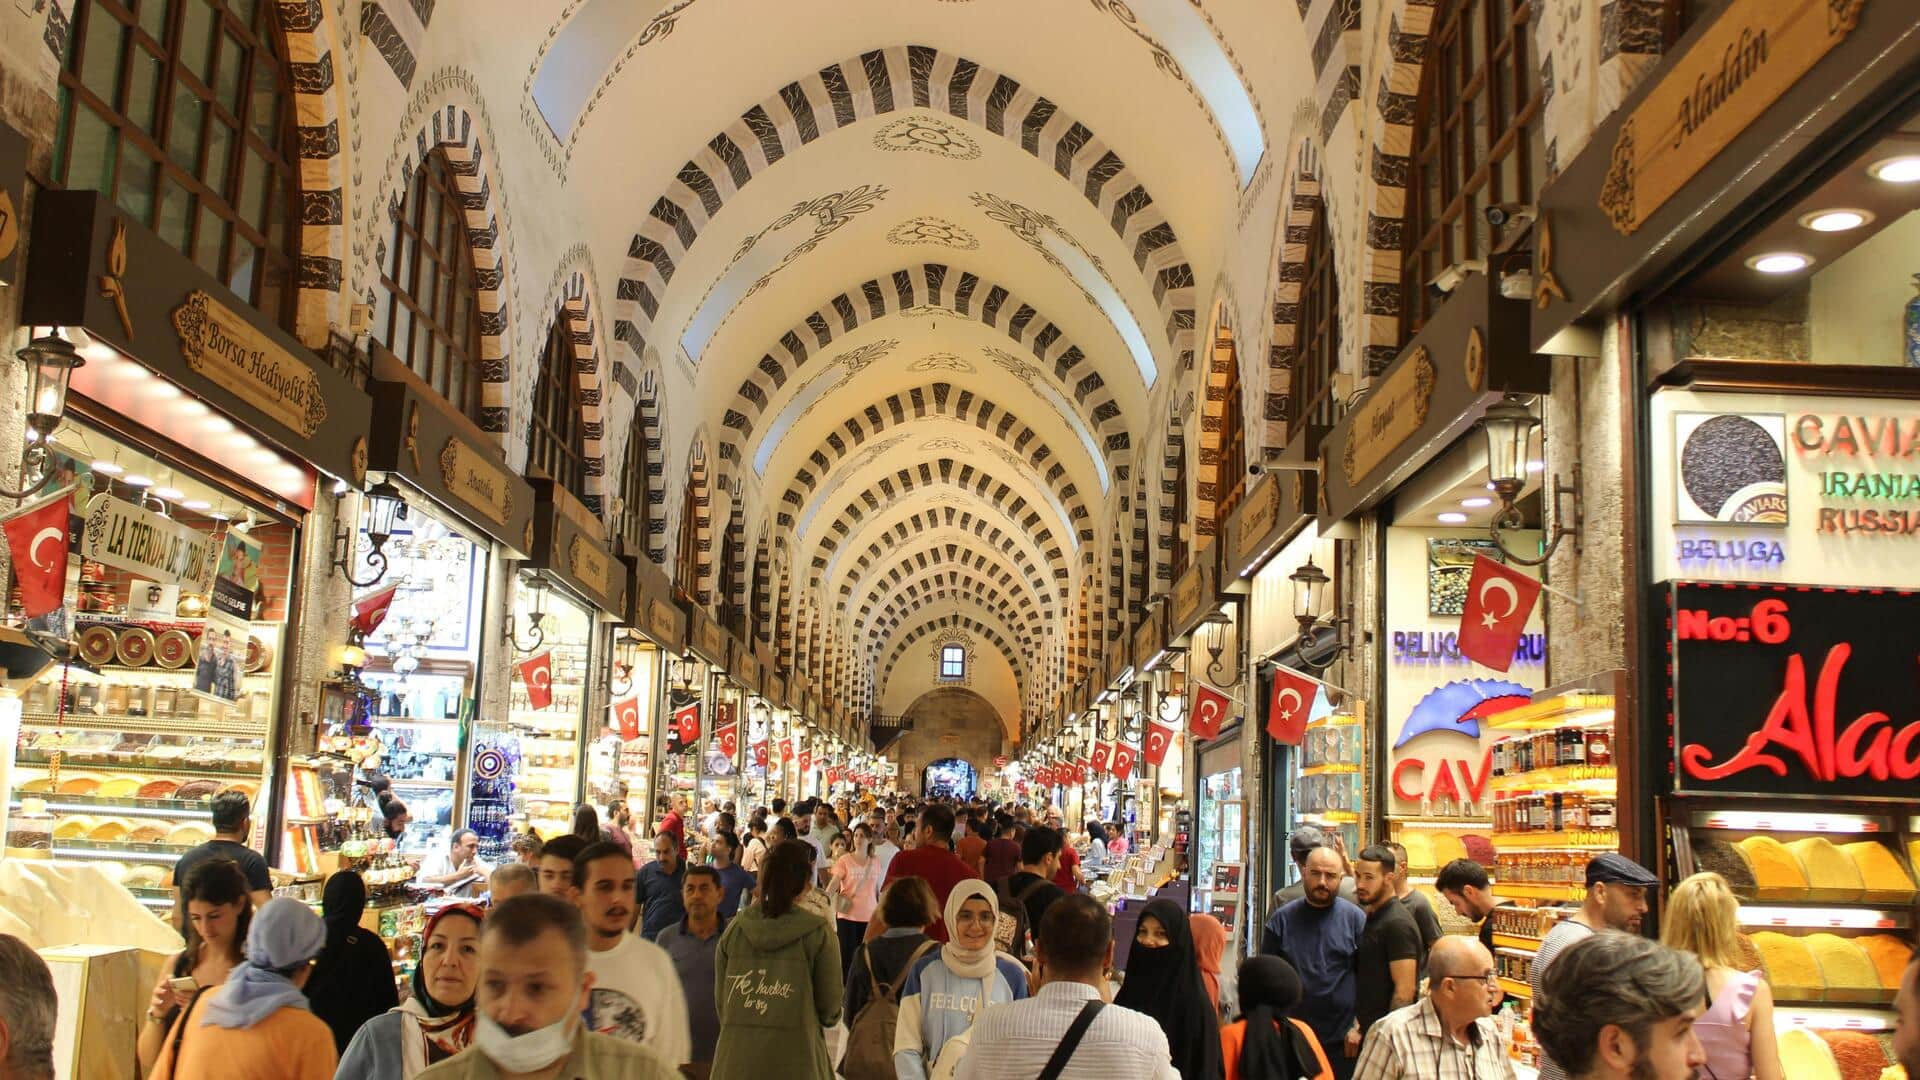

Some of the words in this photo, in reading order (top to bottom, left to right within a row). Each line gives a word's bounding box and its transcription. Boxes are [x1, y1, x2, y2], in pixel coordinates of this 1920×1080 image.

[1673, 26, 1770, 149] Aladdin
[207, 322, 247, 370] Borsa
[248, 351, 306, 407] Hediyelik
[107, 513, 127, 555] LA
[1678, 539, 1786, 563] BELUGA
[1677, 598, 1792, 646] No:6
[1393, 631, 1459, 659] BELUG
[1517, 633, 1546, 660] RU
[727, 969, 755, 1004] The
